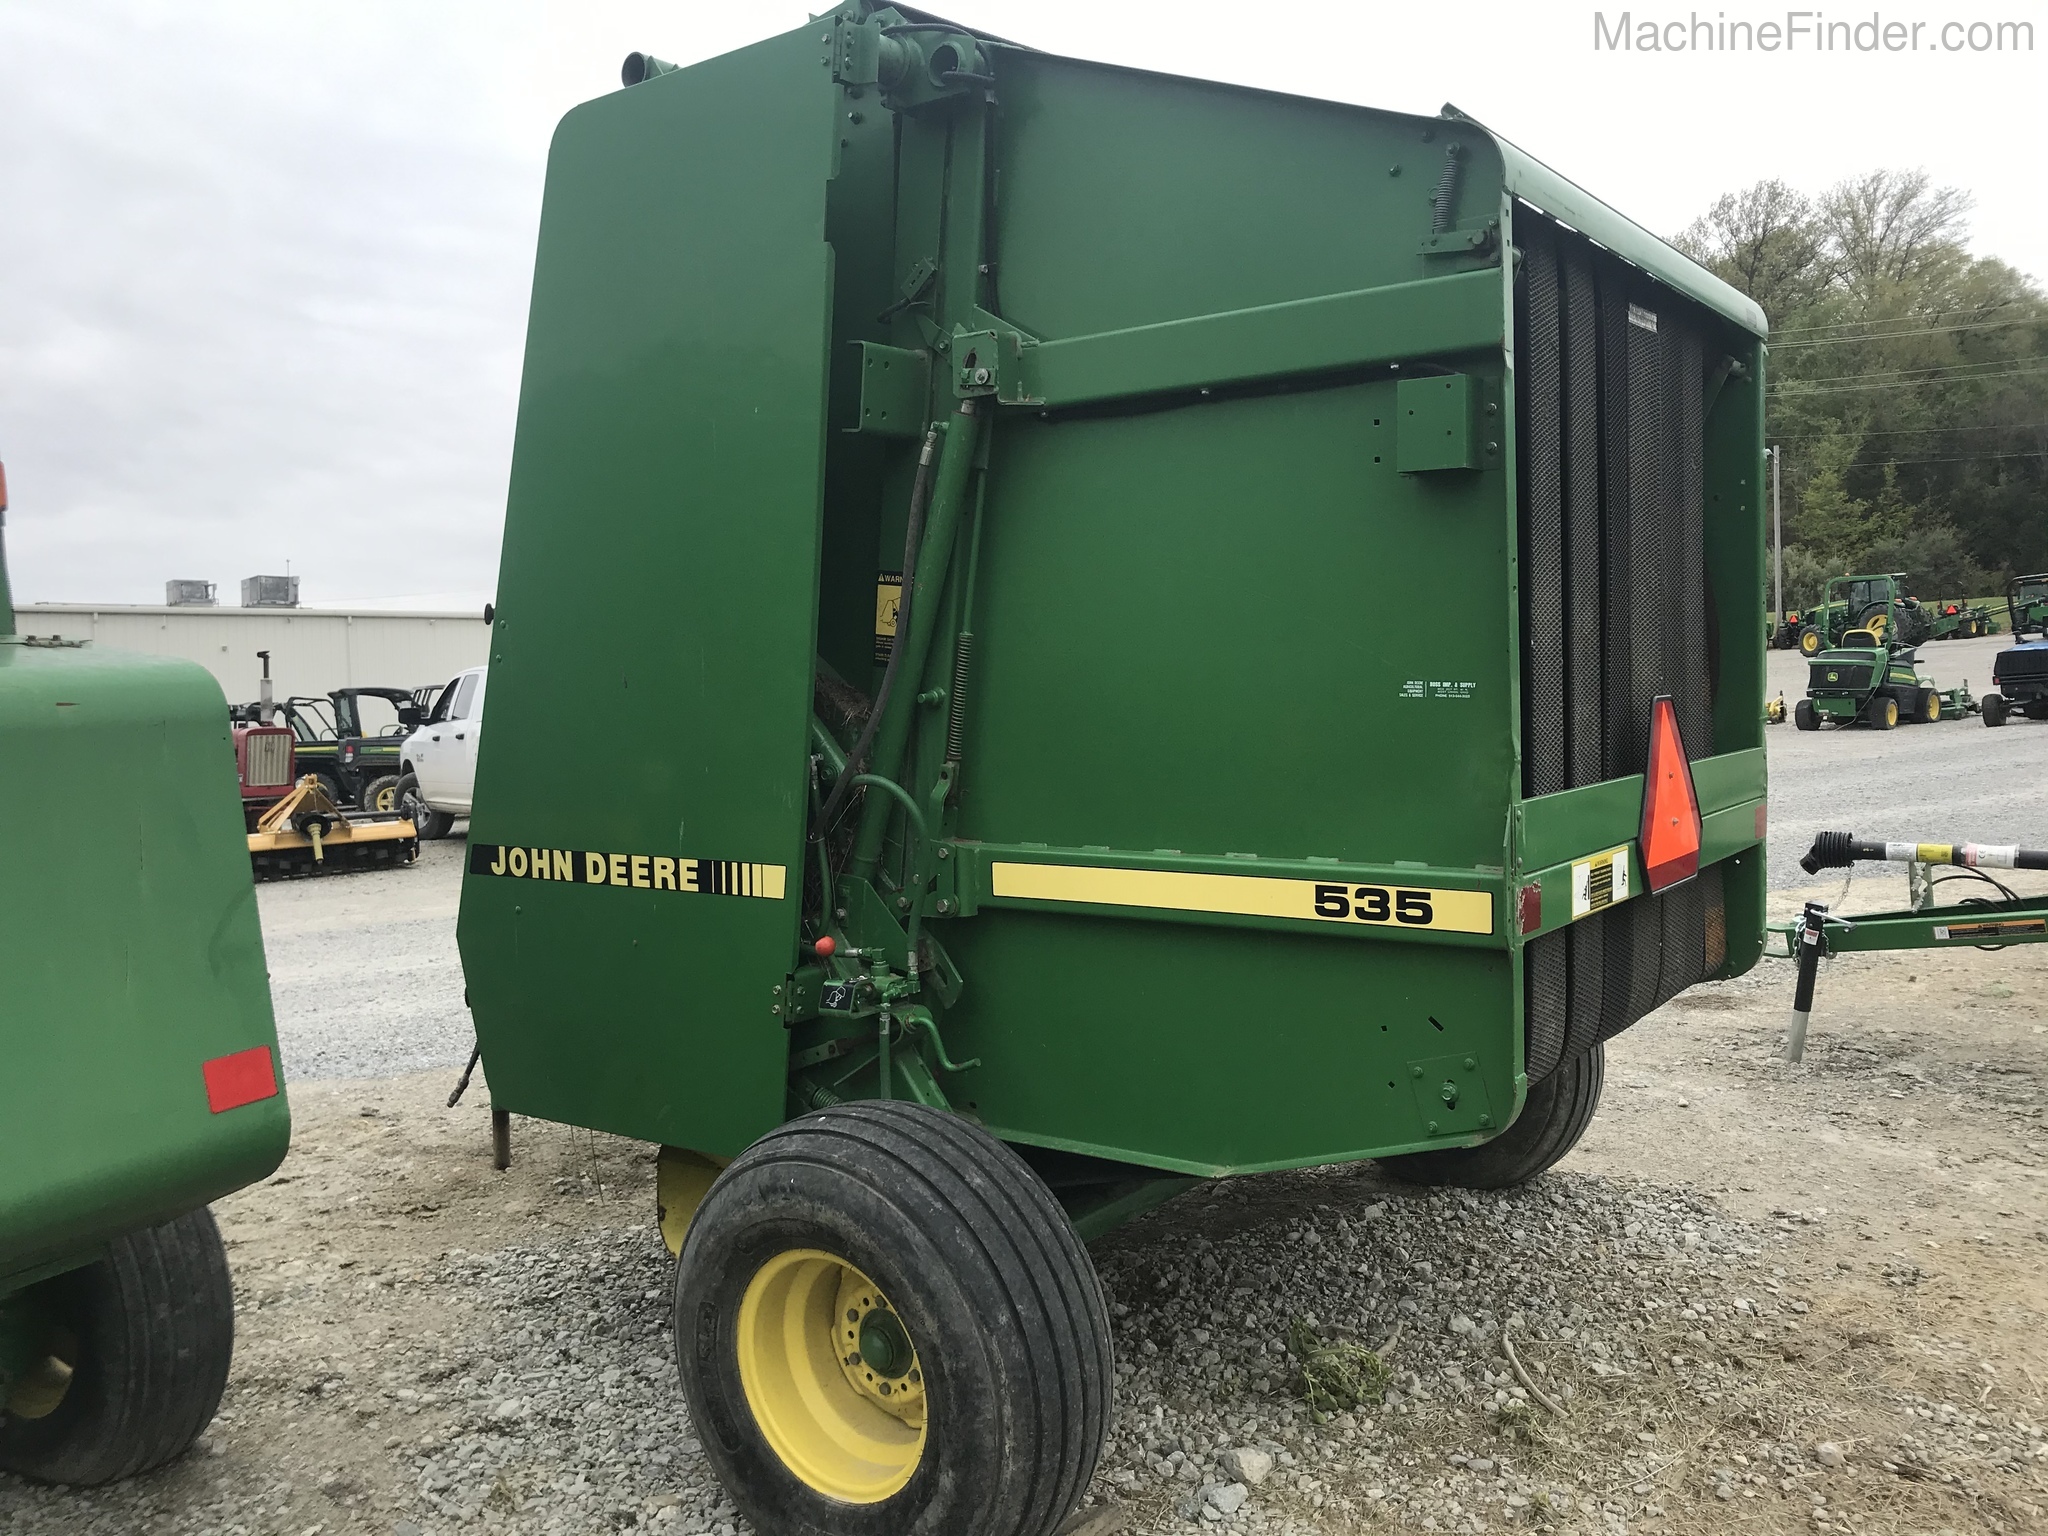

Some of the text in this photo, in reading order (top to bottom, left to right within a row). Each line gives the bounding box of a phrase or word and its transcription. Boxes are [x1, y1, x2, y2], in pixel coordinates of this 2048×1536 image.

[491, 845, 699, 893] JOHN DEERE
[1315, 884, 1433, 925] 535
